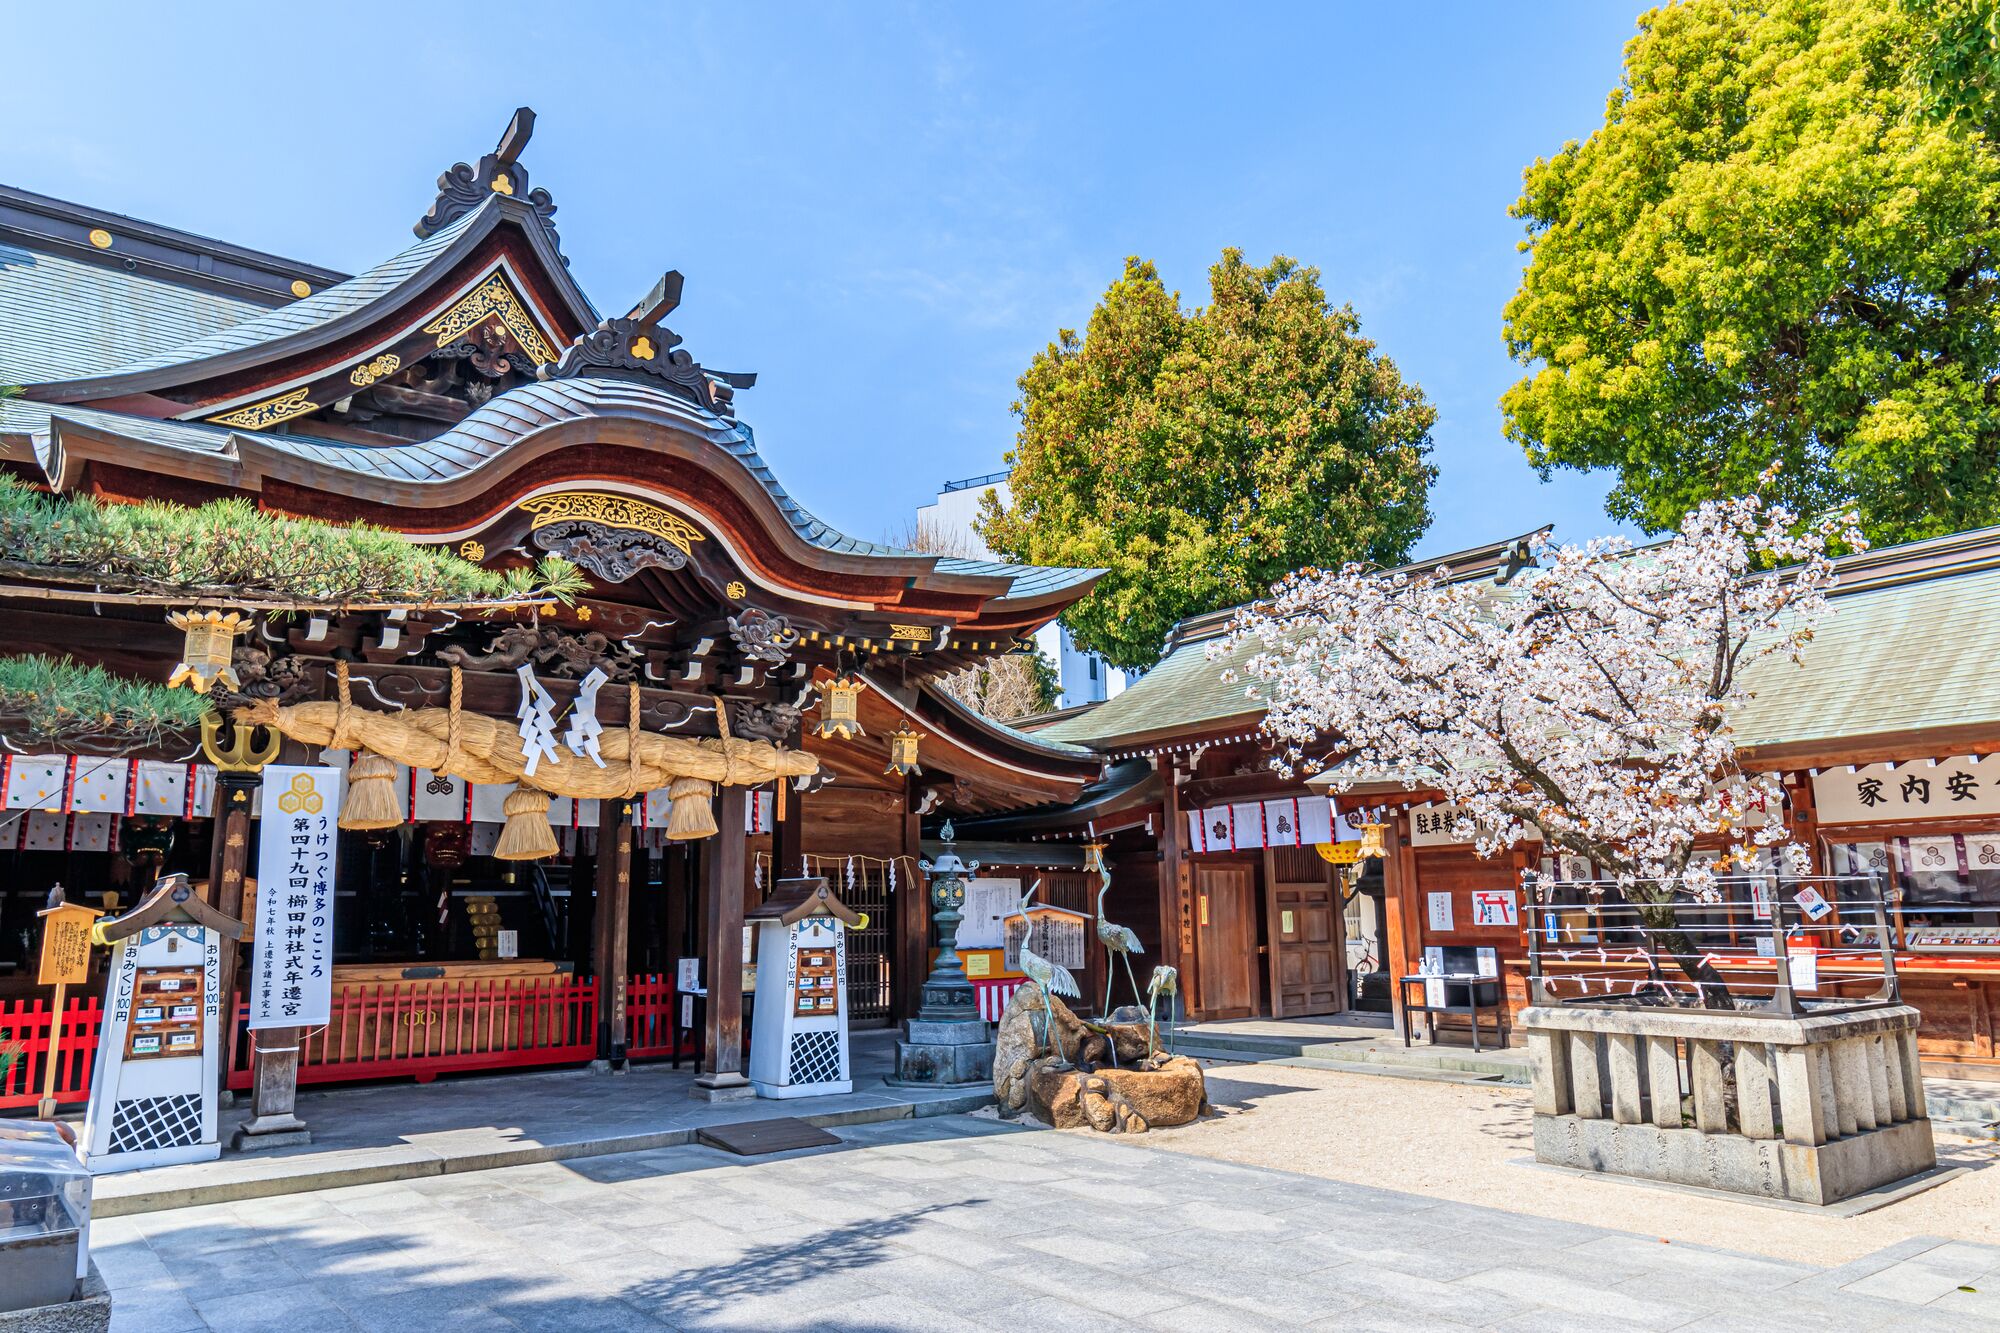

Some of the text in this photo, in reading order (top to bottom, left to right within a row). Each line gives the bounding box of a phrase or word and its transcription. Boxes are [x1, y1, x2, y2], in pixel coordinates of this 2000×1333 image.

[1857, 770, 2000, 808] 家内安
[281, 818, 310, 1016] 第四十九回 櫛田神社式年遷宮
[310, 816, 330, 978] うけつぐ博多のこころ
[115, 946, 137, 1022] おみくじ100円
[205, 944, 219, 1016] おみくじ100円
[787, 933, 798, 988] おみくじ100円
[836, 931, 846, 986] おみくじ100円
